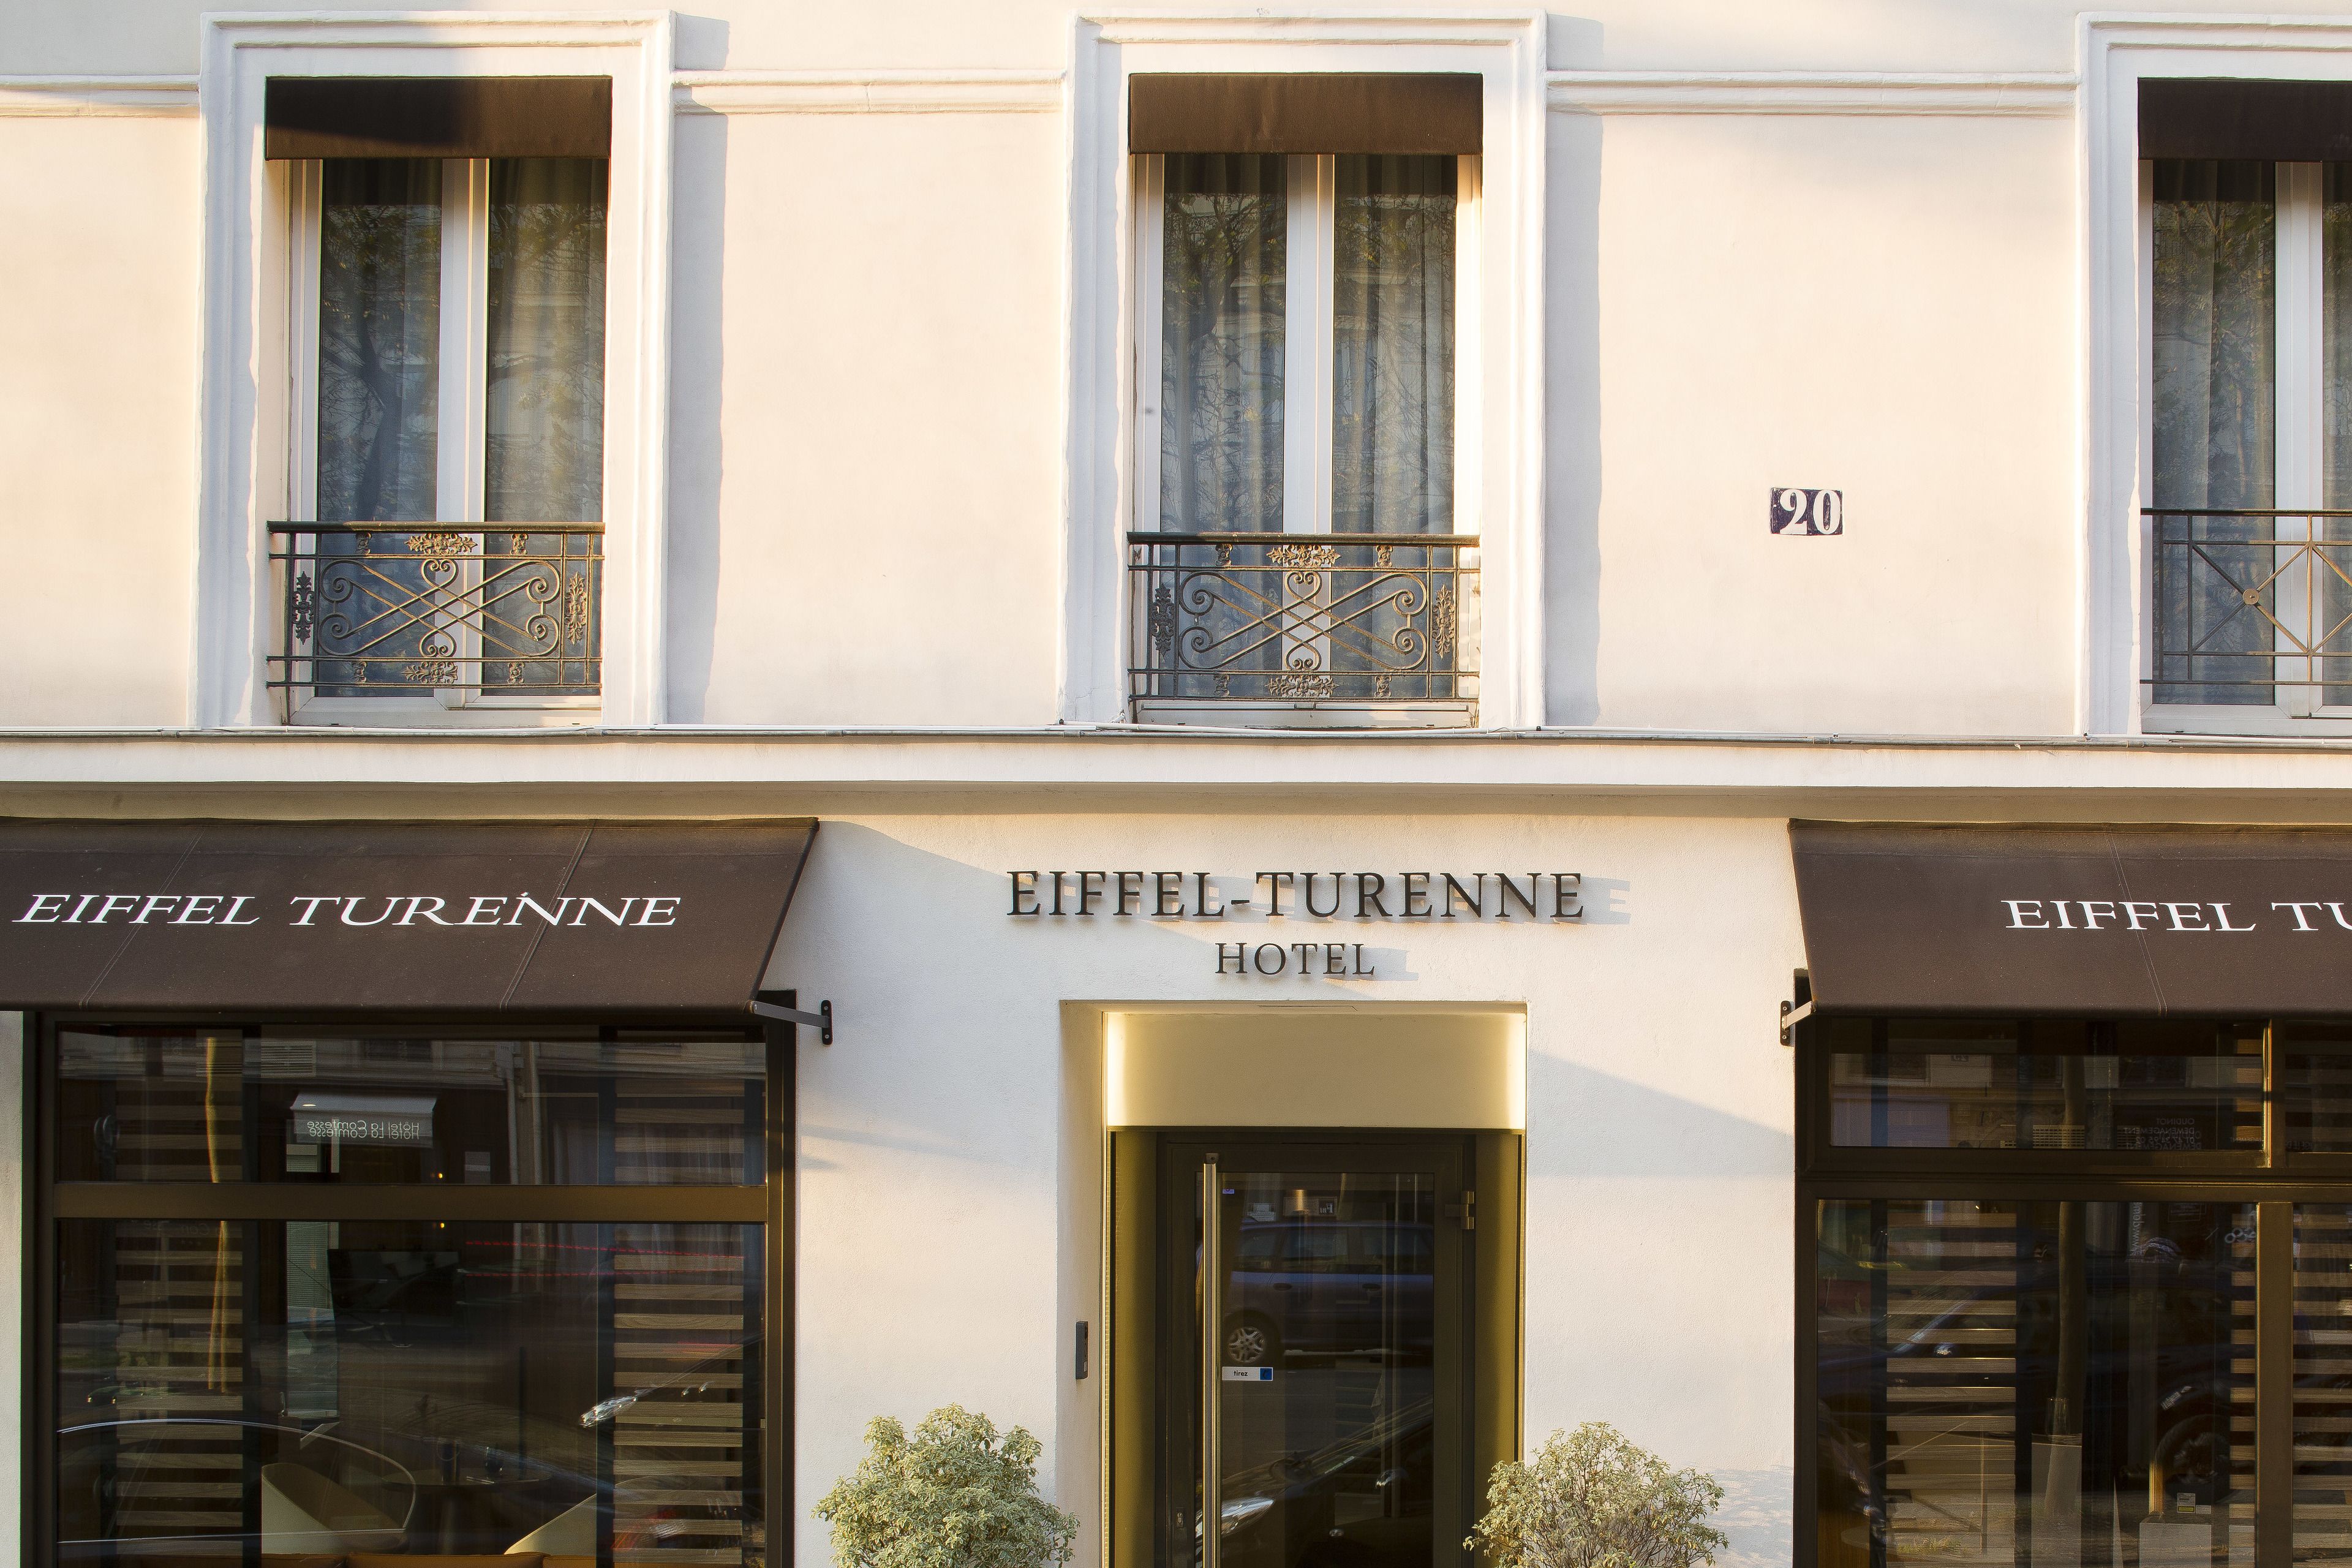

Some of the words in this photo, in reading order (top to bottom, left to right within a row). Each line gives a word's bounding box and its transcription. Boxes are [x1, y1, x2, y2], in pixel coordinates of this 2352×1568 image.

[1780, 489, 1841, 535] 20
[12, 894, 260, 925] EIFFEL
[289, 896, 681, 926] TURENNE
[1006, 870, 1584, 919] EIFFEL-TURENNE
[2000, 900, 2256, 931] EIFFEL
[1215, 942, 1375, 976] HOTEL
